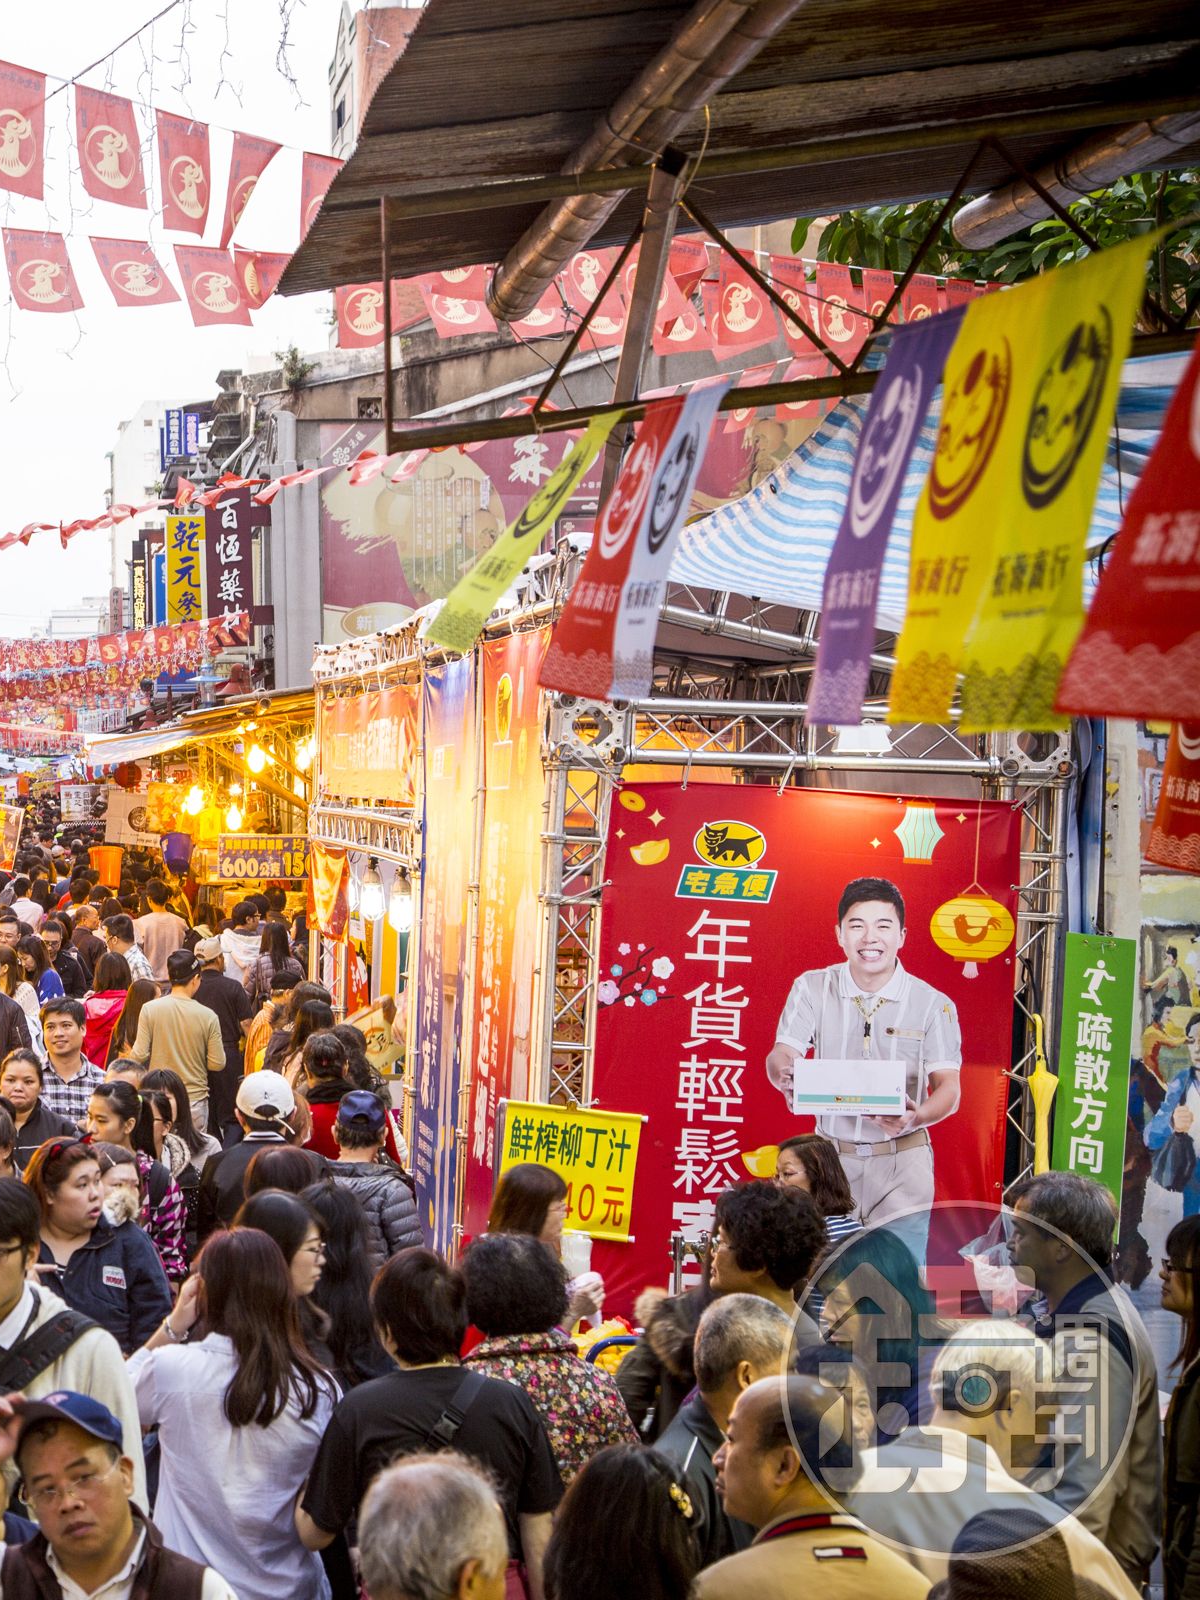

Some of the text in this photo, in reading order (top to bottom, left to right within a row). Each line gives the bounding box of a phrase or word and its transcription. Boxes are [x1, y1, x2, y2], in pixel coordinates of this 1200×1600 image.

[684, 869, 770, 898] 宅急便
[1068, 1011, 1113, 1175] 疏散方向
[508, 1115, 632, 1173] 鮮榨柳丁汁
